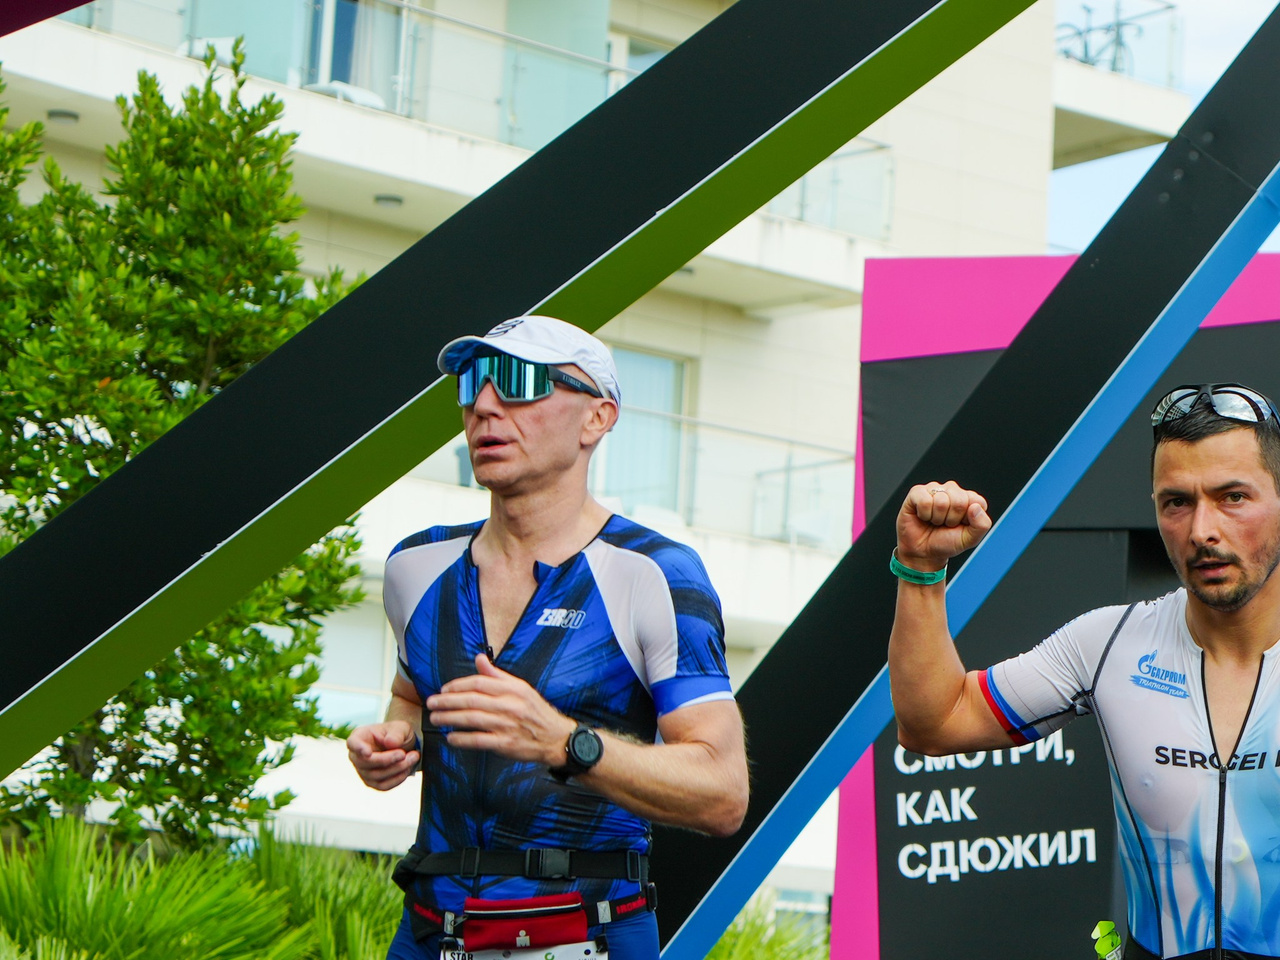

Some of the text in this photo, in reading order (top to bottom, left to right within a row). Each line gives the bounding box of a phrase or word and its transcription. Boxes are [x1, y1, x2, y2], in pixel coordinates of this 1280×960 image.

[1150, 666, 1186, 685] GAZPROM
[1155, 746, 1267, 771] SERGEI
[896, 786, 978, 826] КАК
[898, 828, 1096, 884] СДЮЖИЛ
